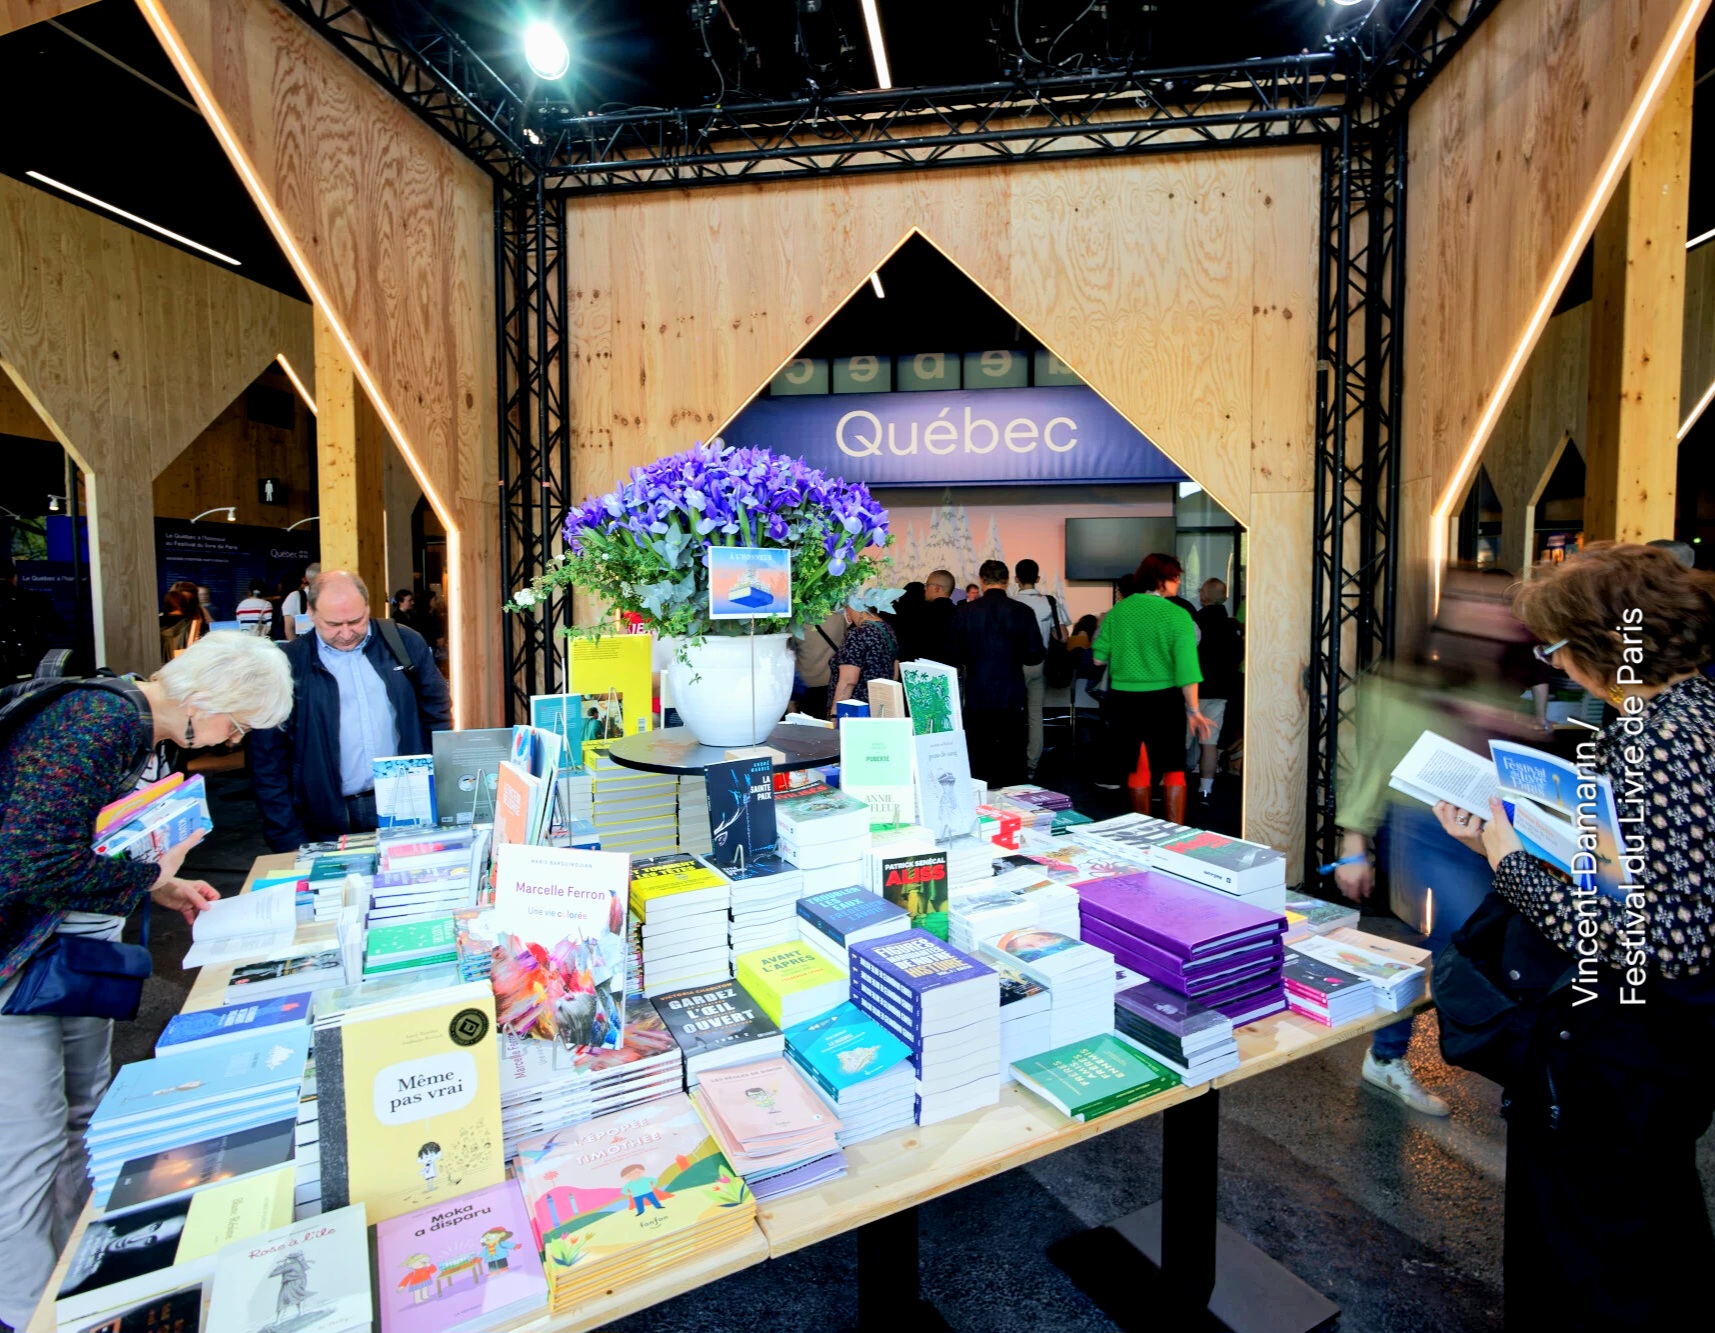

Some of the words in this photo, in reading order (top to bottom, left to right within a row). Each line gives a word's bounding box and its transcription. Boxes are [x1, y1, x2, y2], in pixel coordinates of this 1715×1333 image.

[835, 406, 1078, 458] Québec
[270, 549, 298, 559] Québec
[750, 784, 771, 793] SAINTE
[762, 775, 771, 784] LA
[757, 792, 772, 801] PAIX
[177, 817, 189, 842] KUKU
[884, 860, 913, 871] PATRICK
[886, 864, 947, 887] ALISS
[515, 881, 564, 897] Marcelle
[567, 887, 606, 900] Ferron
[805, 886, 861, 904] TROUBLER
[819, 897, 841, 907] LES
[832, 898, 863, 912] EAUX
[528, 906, 543, 916] Une
[544, 907, 556, 917] vie
[556, 909, 588, 920] colorée
[874, 938, 935, 957] FIGURES
[761, 949, 802, 966] AVANT
[904, 957, 969, 978] HISTOIRE
[660, 990, 695, 1001] VICTORIA
[695, 982, 733, 994] CHARLTON
[668, 989, 737, 1010] GARDEZ
[686, 1002, 735, 1019] L'ŒIL
[682, 1009, 755, 1034] OUVERT
[511, 1047, 526, 1080] Marcelle
[1081, 1048, 1125, 1079] ENNEMIS
[398, 1071, 455, 1092] Même
[389, 1094, 423, 1113] pas
[427, 1078, 464, 1099] vrai
[574, 1118, 650, 1147] L'ÉPOPÉE
[575, 1131, 663, 1166] TIMOTHÉE
[414, 1227, 426, 1238] a
[428, 1206, 492, 1234] disparu
[431, 1204, 474, 1223] Moka
[248, 1242, 287, 1260] Rose
